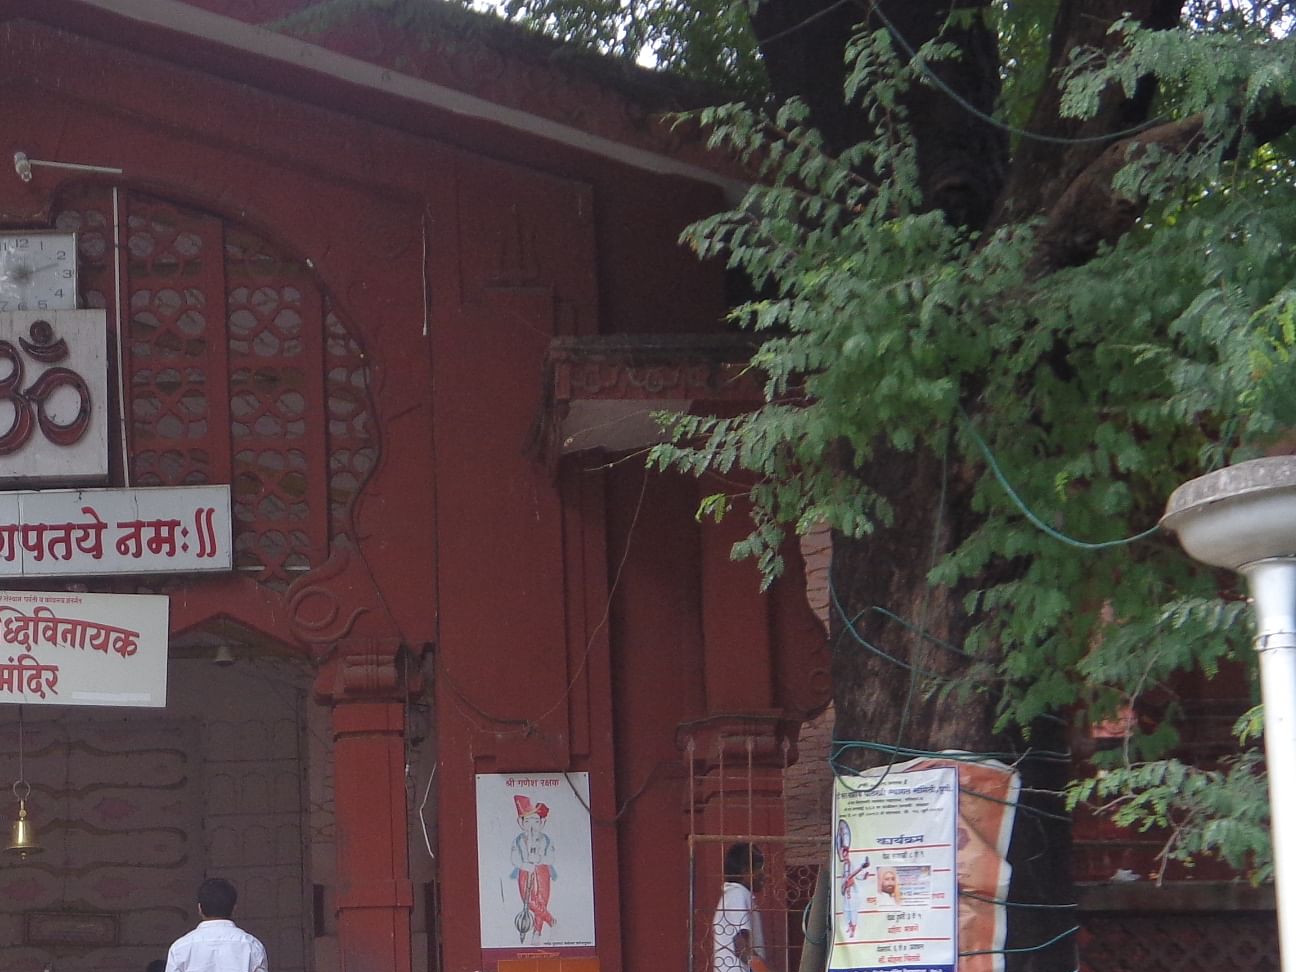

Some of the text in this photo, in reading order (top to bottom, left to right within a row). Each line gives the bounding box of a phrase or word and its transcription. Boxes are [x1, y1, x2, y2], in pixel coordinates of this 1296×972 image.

[15, 238, 30, 248] 12
[56, 250, 66, 260] 2
[62, 269, 72, 279] 3
[54, 288, 63, 298] 4
[38, 300, 48, 310] 5
[116, 518, 190, 557] नमः
[506, 778, 515, 787] श्री
[518, 777, 538, 788] गणेश
[876, 833, 924, 845] कार्यक्रम
